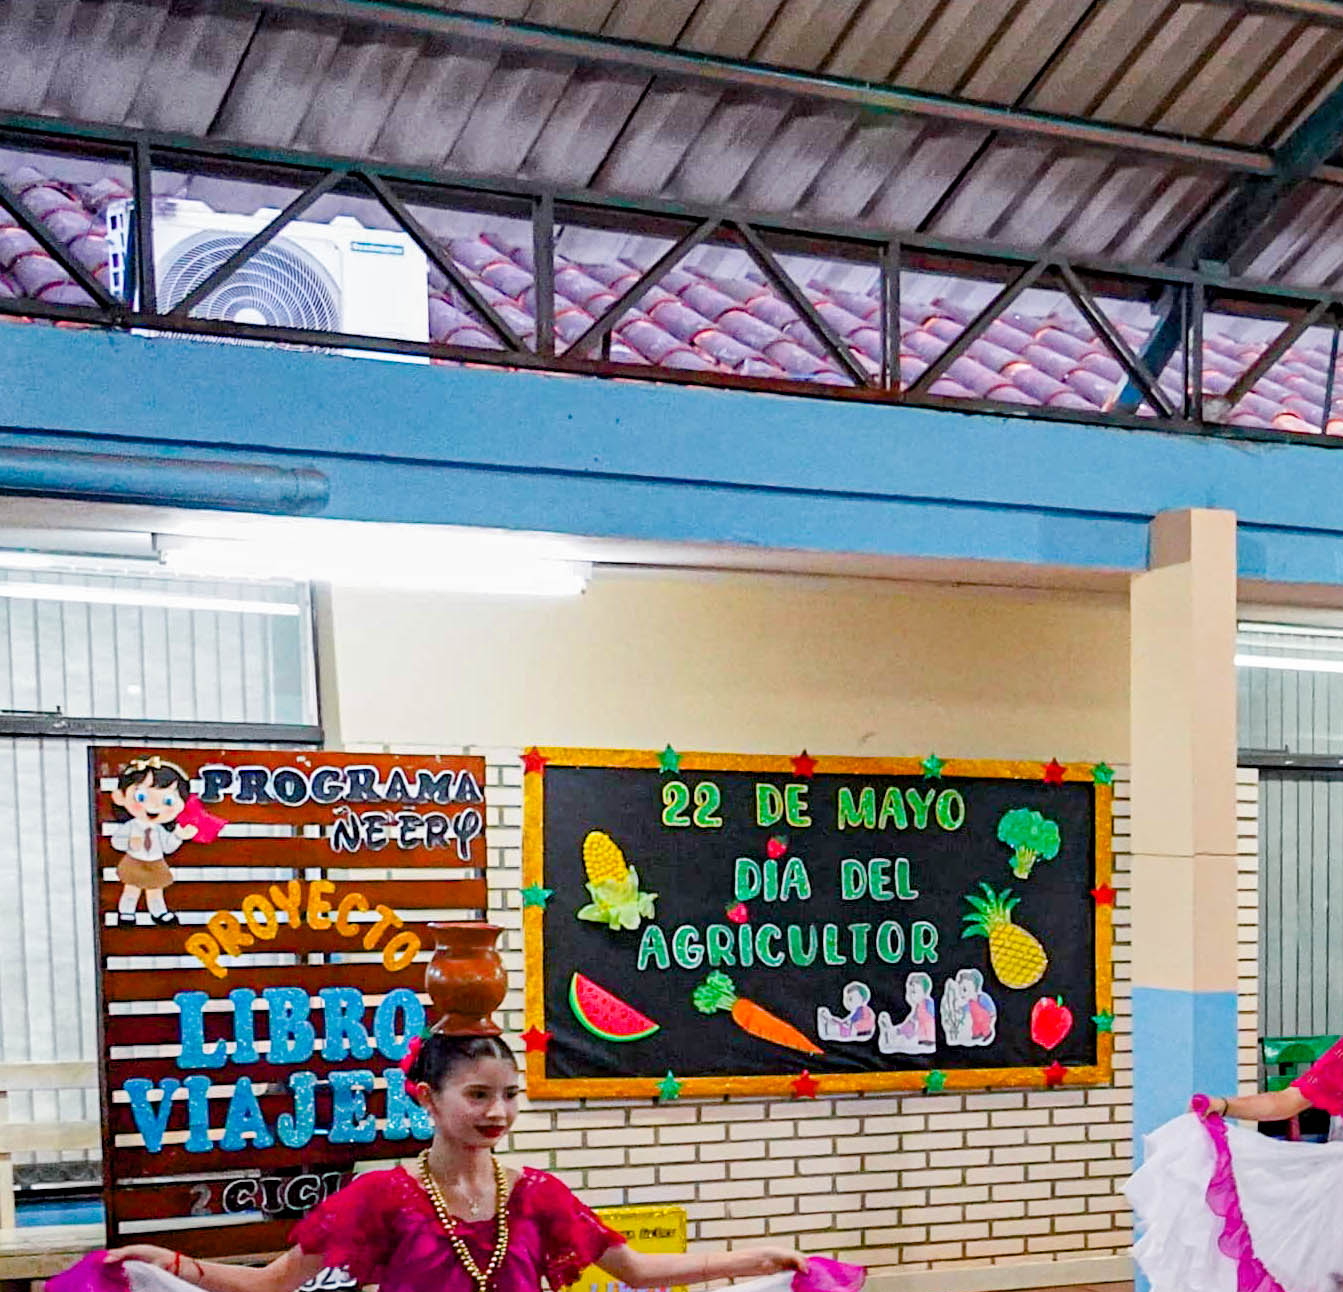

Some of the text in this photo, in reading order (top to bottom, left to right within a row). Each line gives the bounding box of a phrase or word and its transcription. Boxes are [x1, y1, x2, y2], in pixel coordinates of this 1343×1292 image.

[199, 766, 484, 805] PROGRAMA
[662, 781, 966, 831] 22 DE MAYO
[841, 858, 920, 901] DEL
[184, 879, 422, 979] PROYECTO
[637, 920, 940, 971] AGRICULTOR
[173, 986, 427, 1069] LIBRO
[122, 1067, 435, 1153] VIAJER
[189, 1183, 212, 1216] 2
